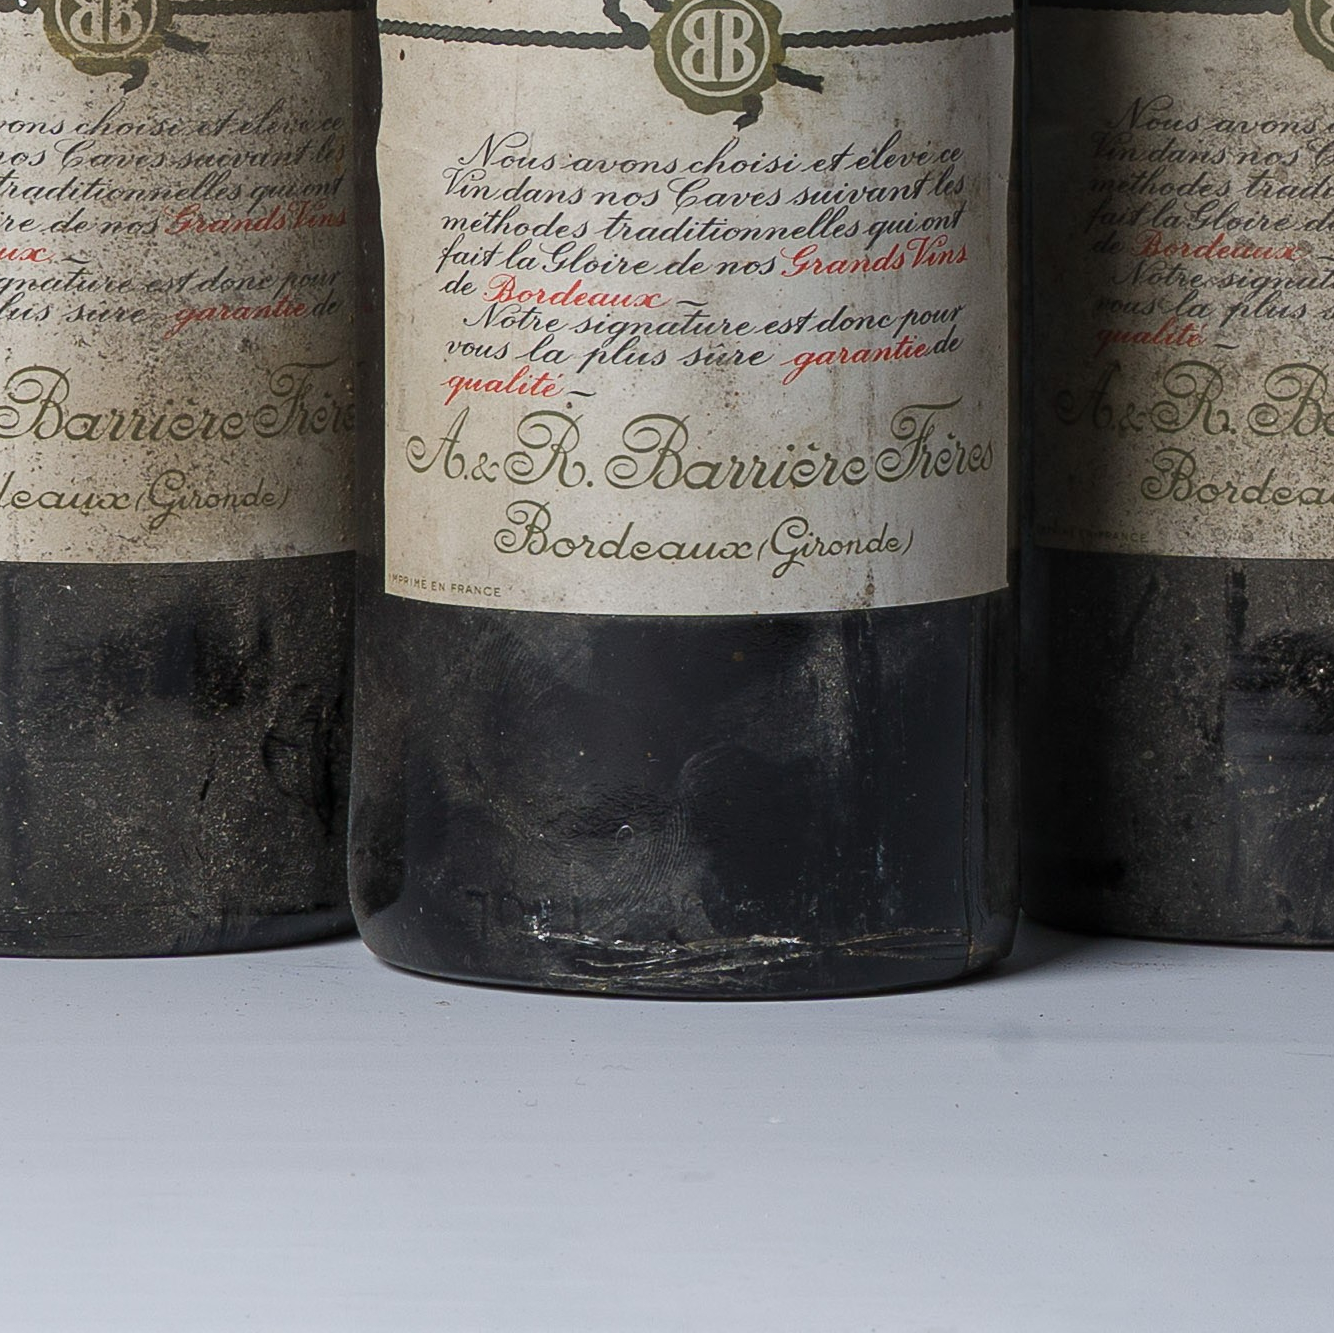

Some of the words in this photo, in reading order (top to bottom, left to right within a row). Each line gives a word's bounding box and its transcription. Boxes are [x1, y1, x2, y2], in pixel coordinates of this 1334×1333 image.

[457, 131, 557, 172] Nous
[559, 155, 679, 175] avons
[679, 136, 802, 175] choisi
[802, 142, 854, 173] et
[441, 166, 497, 202] Vin
[494, 175, 585, 206] dans
[590, 185, 661, 208] nos
[667, 175, 782, 215] Caves
[785, 171, 932, 207] suivant
[928, 163, 966, 196] les
[440, 203, 590, 239] méthodes
[594, 204, 861, 242] traditionnelles
[860, 211, 920, 251] qui
[917, 199, 968, 232] ont
[434, 232, 503, 274] fait
[499, 237, 541, 271] la
[538, 240, 659, 275] Gloire
[654, 247, 713, 276] de
[714, 253, 779, 276] nos
[779, 241, 906, 278] Grands
[905, 233, 969, 269] Vins
[438, 269, 477, 296] de
[481, 272, 672, 309] Bordeaux
[462, 300, 568, 334] Notre
[568, 309, 755, 348] signature
[755, 306, 817, 335] est
[810, 304, 901, 333] donc
[892, 302, 966, 339] pour
[444, 339, 511, 361] vous
[515, 333, 570, 365] la
[574, 335, 667, 374] plus
[676, 343, 775, 367] sûre
[779, 333, 931, 386] garantie
[928, 324, 965, 357] de
[438, 364, 564, 406] qualité
[604, 412, 869, 490] Barrière
[872, 395, 995, 482] Frères
[493, 499, 757, 563] Bordeaux
[758, 515, 915, 579] (Gironde)
[431, 581, 446, 592] EN
[450, 582, 502, 598] FRANCE
